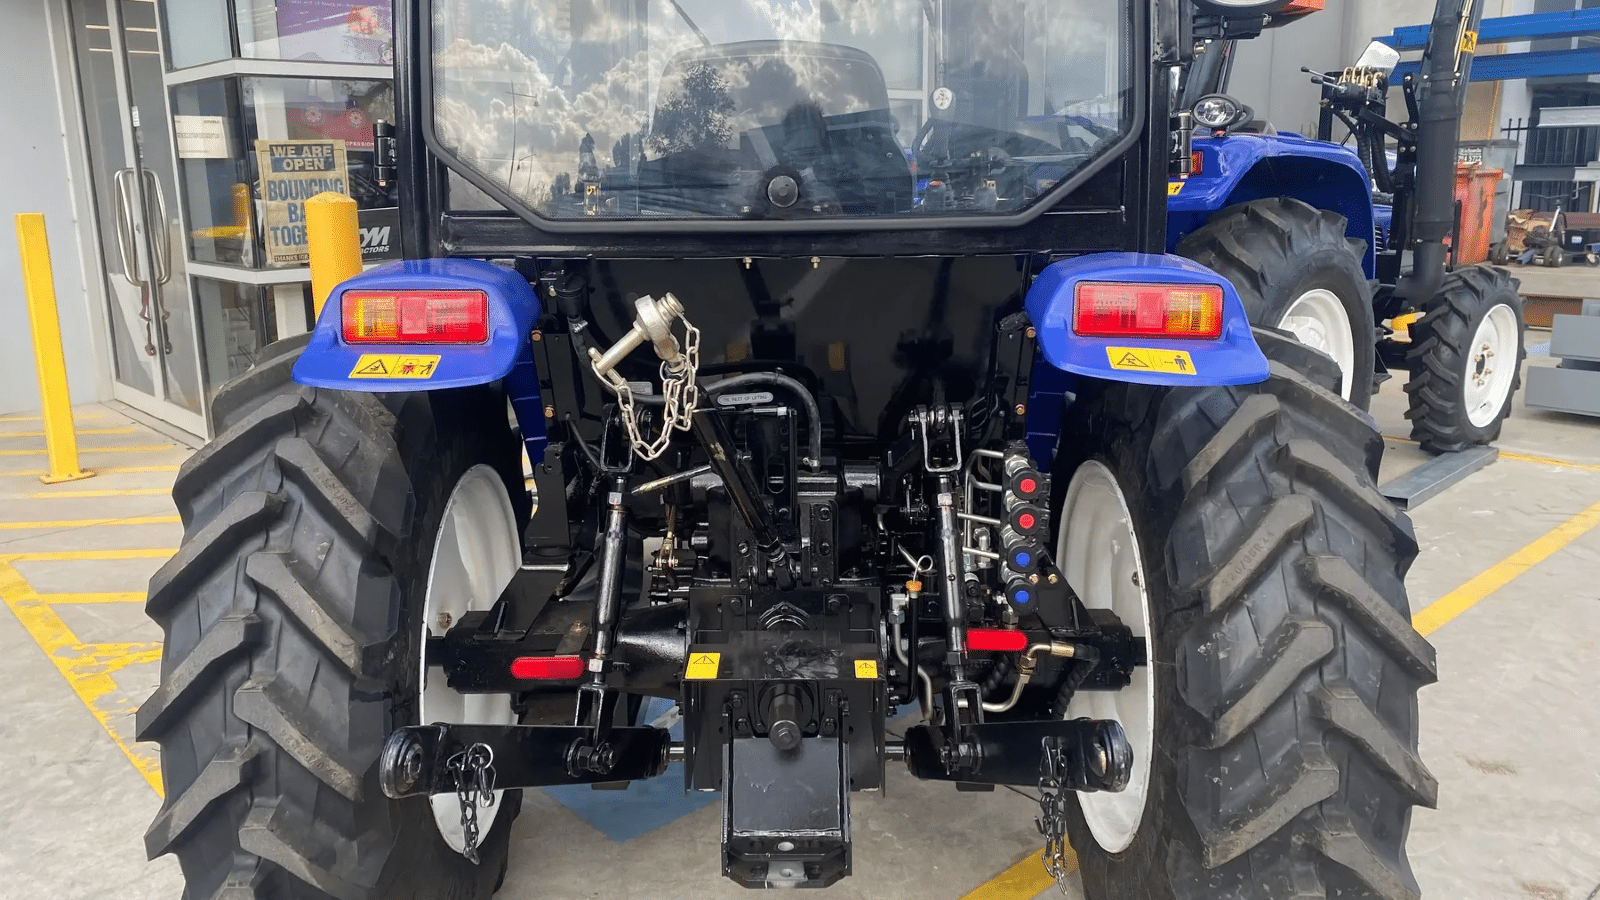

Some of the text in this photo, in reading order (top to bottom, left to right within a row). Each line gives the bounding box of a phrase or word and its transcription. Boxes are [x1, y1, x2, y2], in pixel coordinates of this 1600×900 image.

[272, 145, 332, 158] WE ARE
[282, 158, 325, 171] OPEN
[267, 179, 344, 202] BOUNCING
[359, 226, 391, 247] YM
